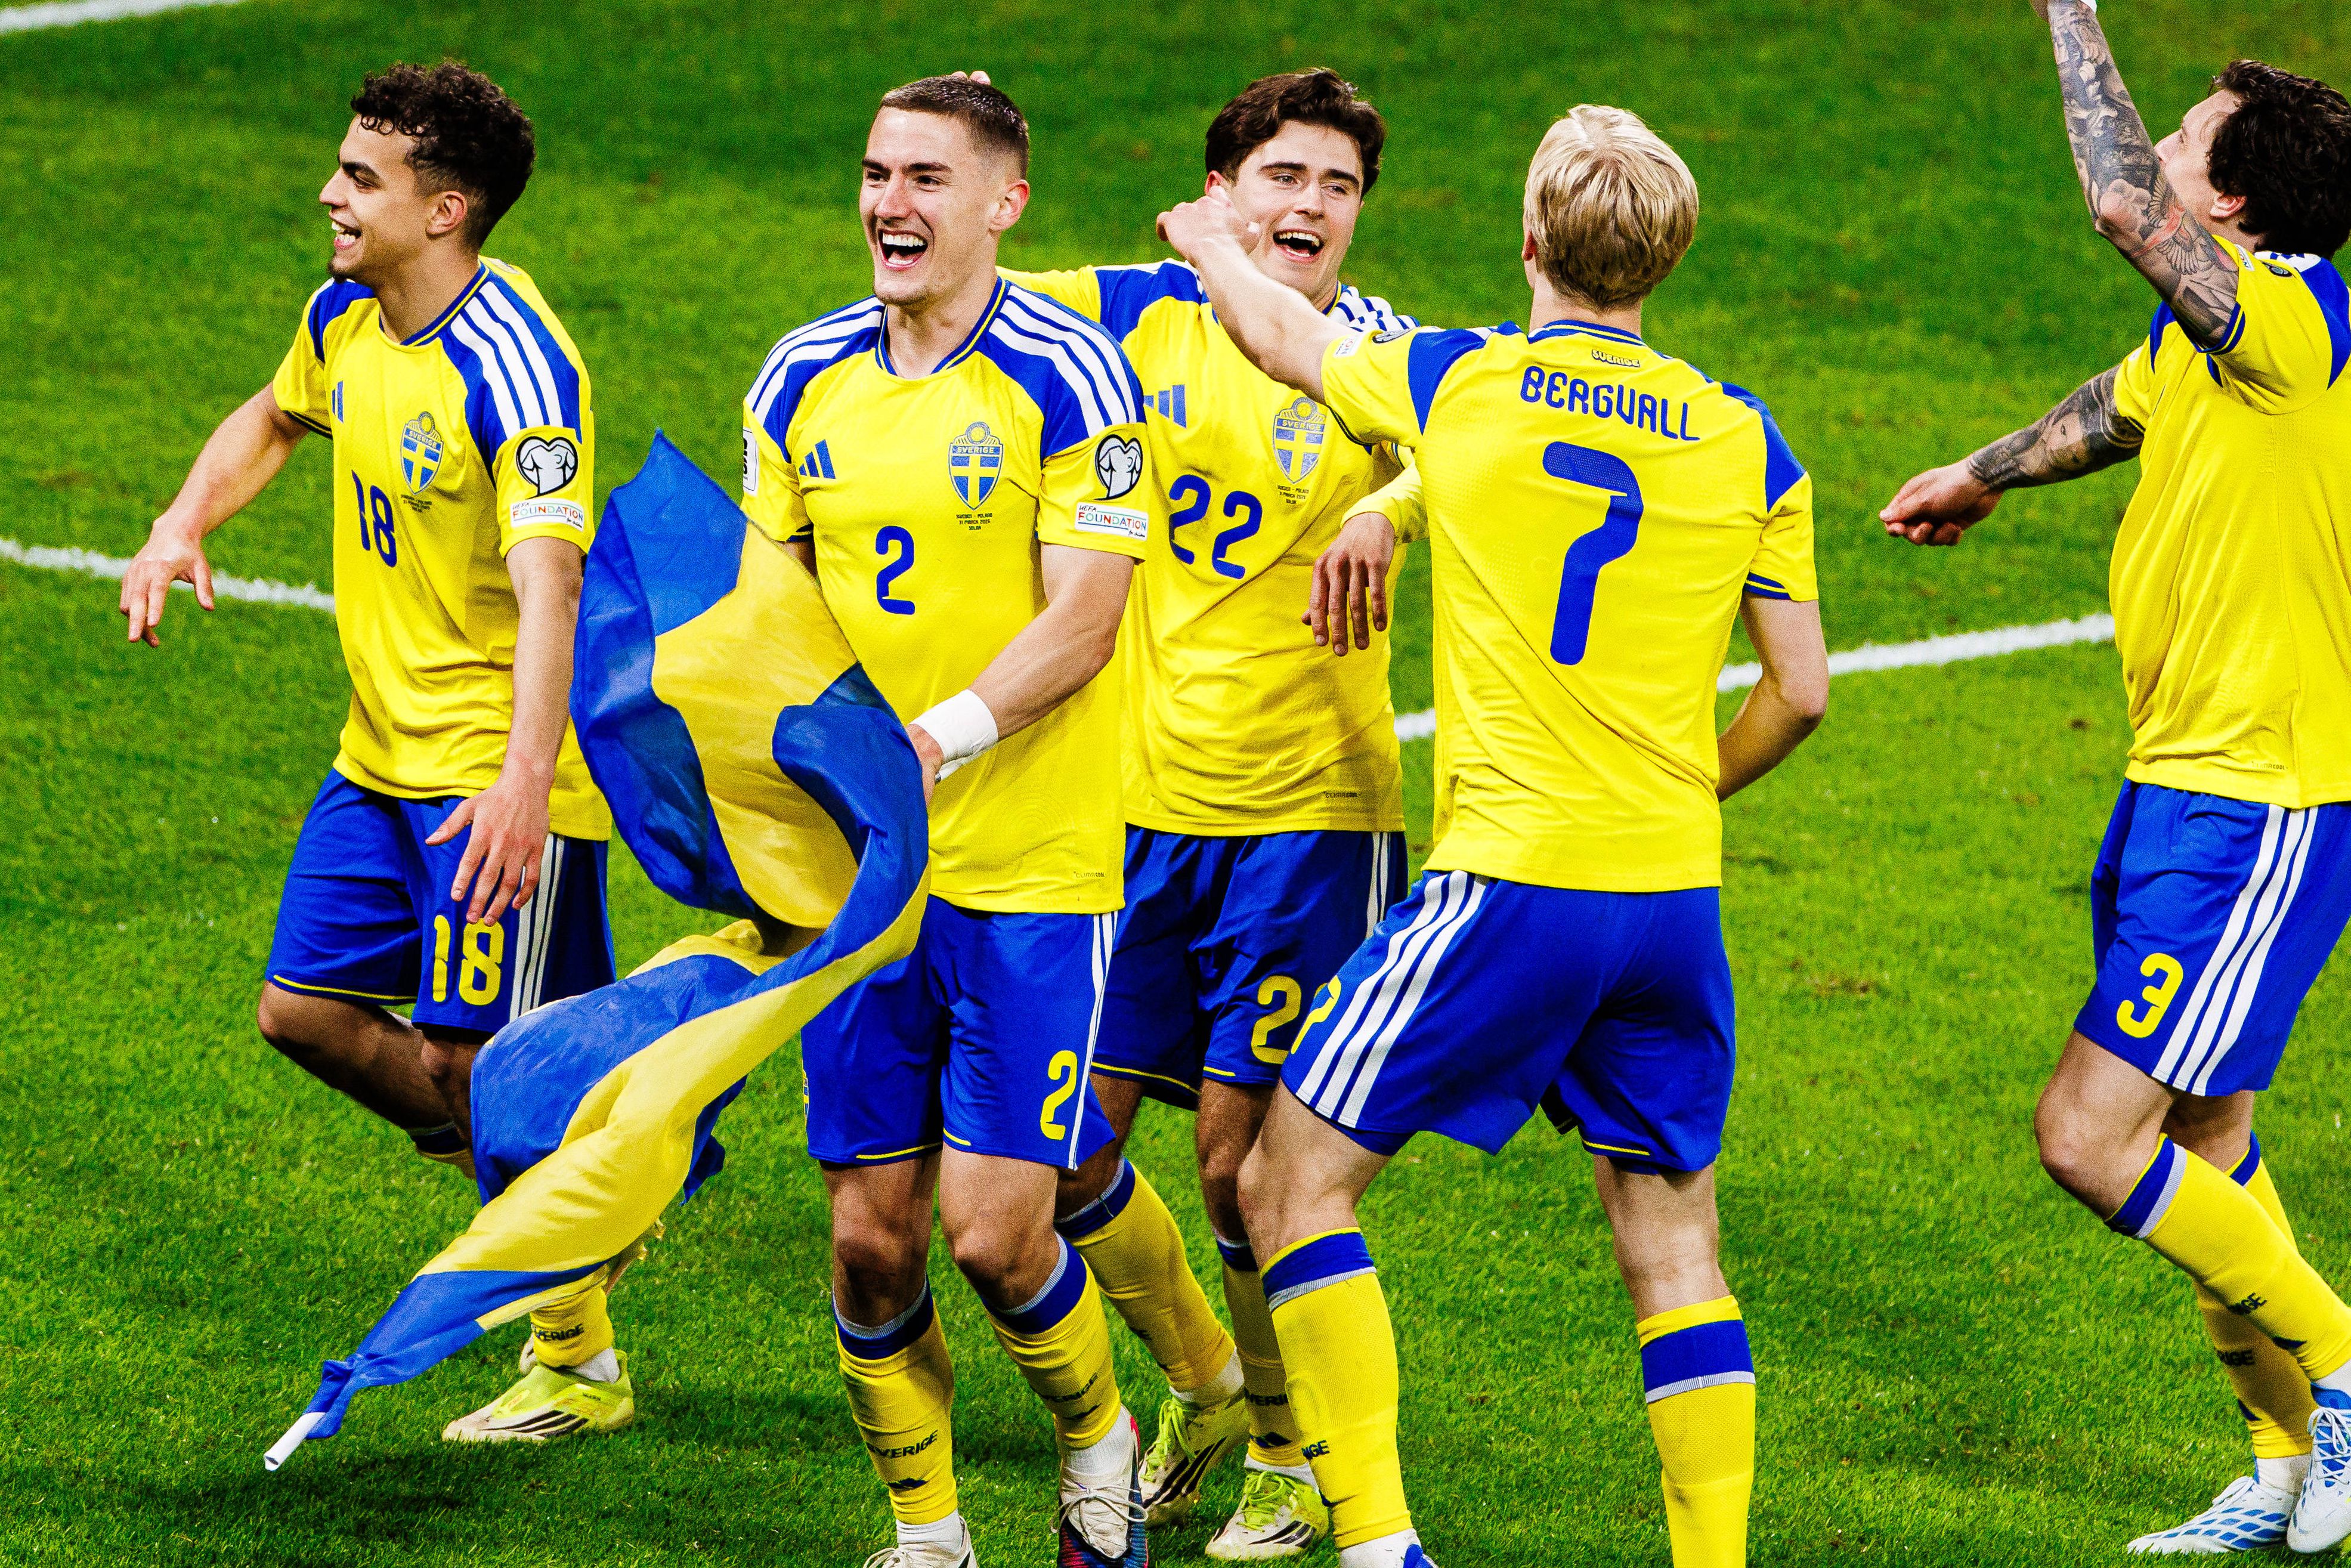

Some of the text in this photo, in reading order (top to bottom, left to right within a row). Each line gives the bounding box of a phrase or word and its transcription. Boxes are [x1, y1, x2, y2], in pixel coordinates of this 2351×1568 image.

[1591, 349, 1641, 367] SVERIGE
[1282, 419, 1322, 431] SVERIGE
[1520, 366, 1701, 441] BERGVALL
[957, 446, 995, 454] SVERIGE
[351, 469, 398, 568] 18
[513, 506, 583, 522] FOUNDATION
[1078, 511, 1147, 531] FOUNDATION
[1168, 474, 1263, 580] 22
[1542, 441, 1644, 666] 7
[875, 525, 916, 616] 2
[432, 914, 505, 1006] 18
[2116, 952, 2183, 1038] 3
[1251, 975, 1327, 1065] 2
[1040, 1050, 1077, 1140] 2
